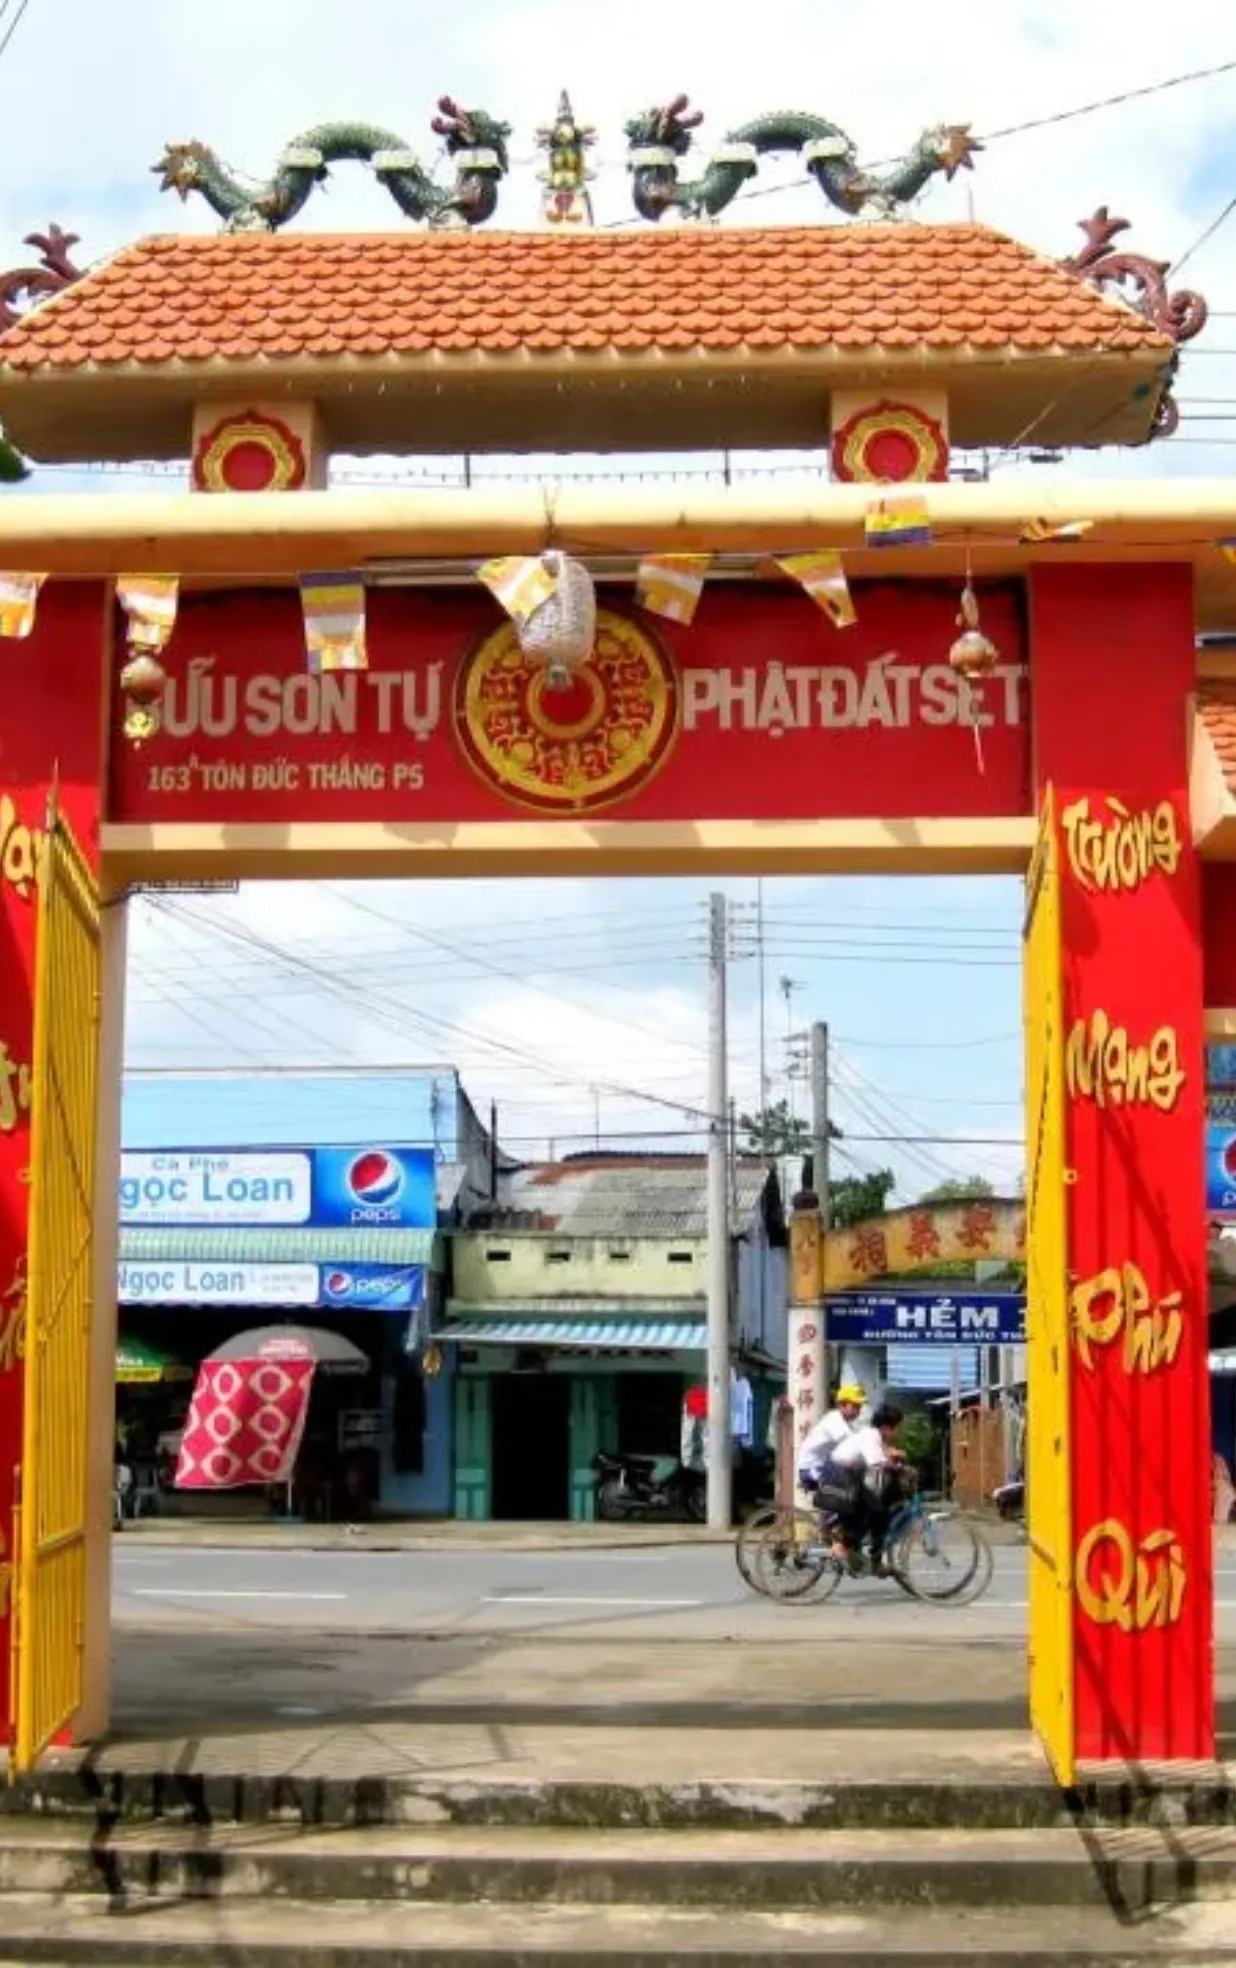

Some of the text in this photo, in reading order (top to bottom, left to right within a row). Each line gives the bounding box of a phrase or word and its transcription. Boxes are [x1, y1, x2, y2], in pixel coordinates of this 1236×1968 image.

[119, 1170, 294, 1209] gọc Loan
[183, 1266, 246, 1293] Loan
[1071, 1260, 1182, 1376] Phú
